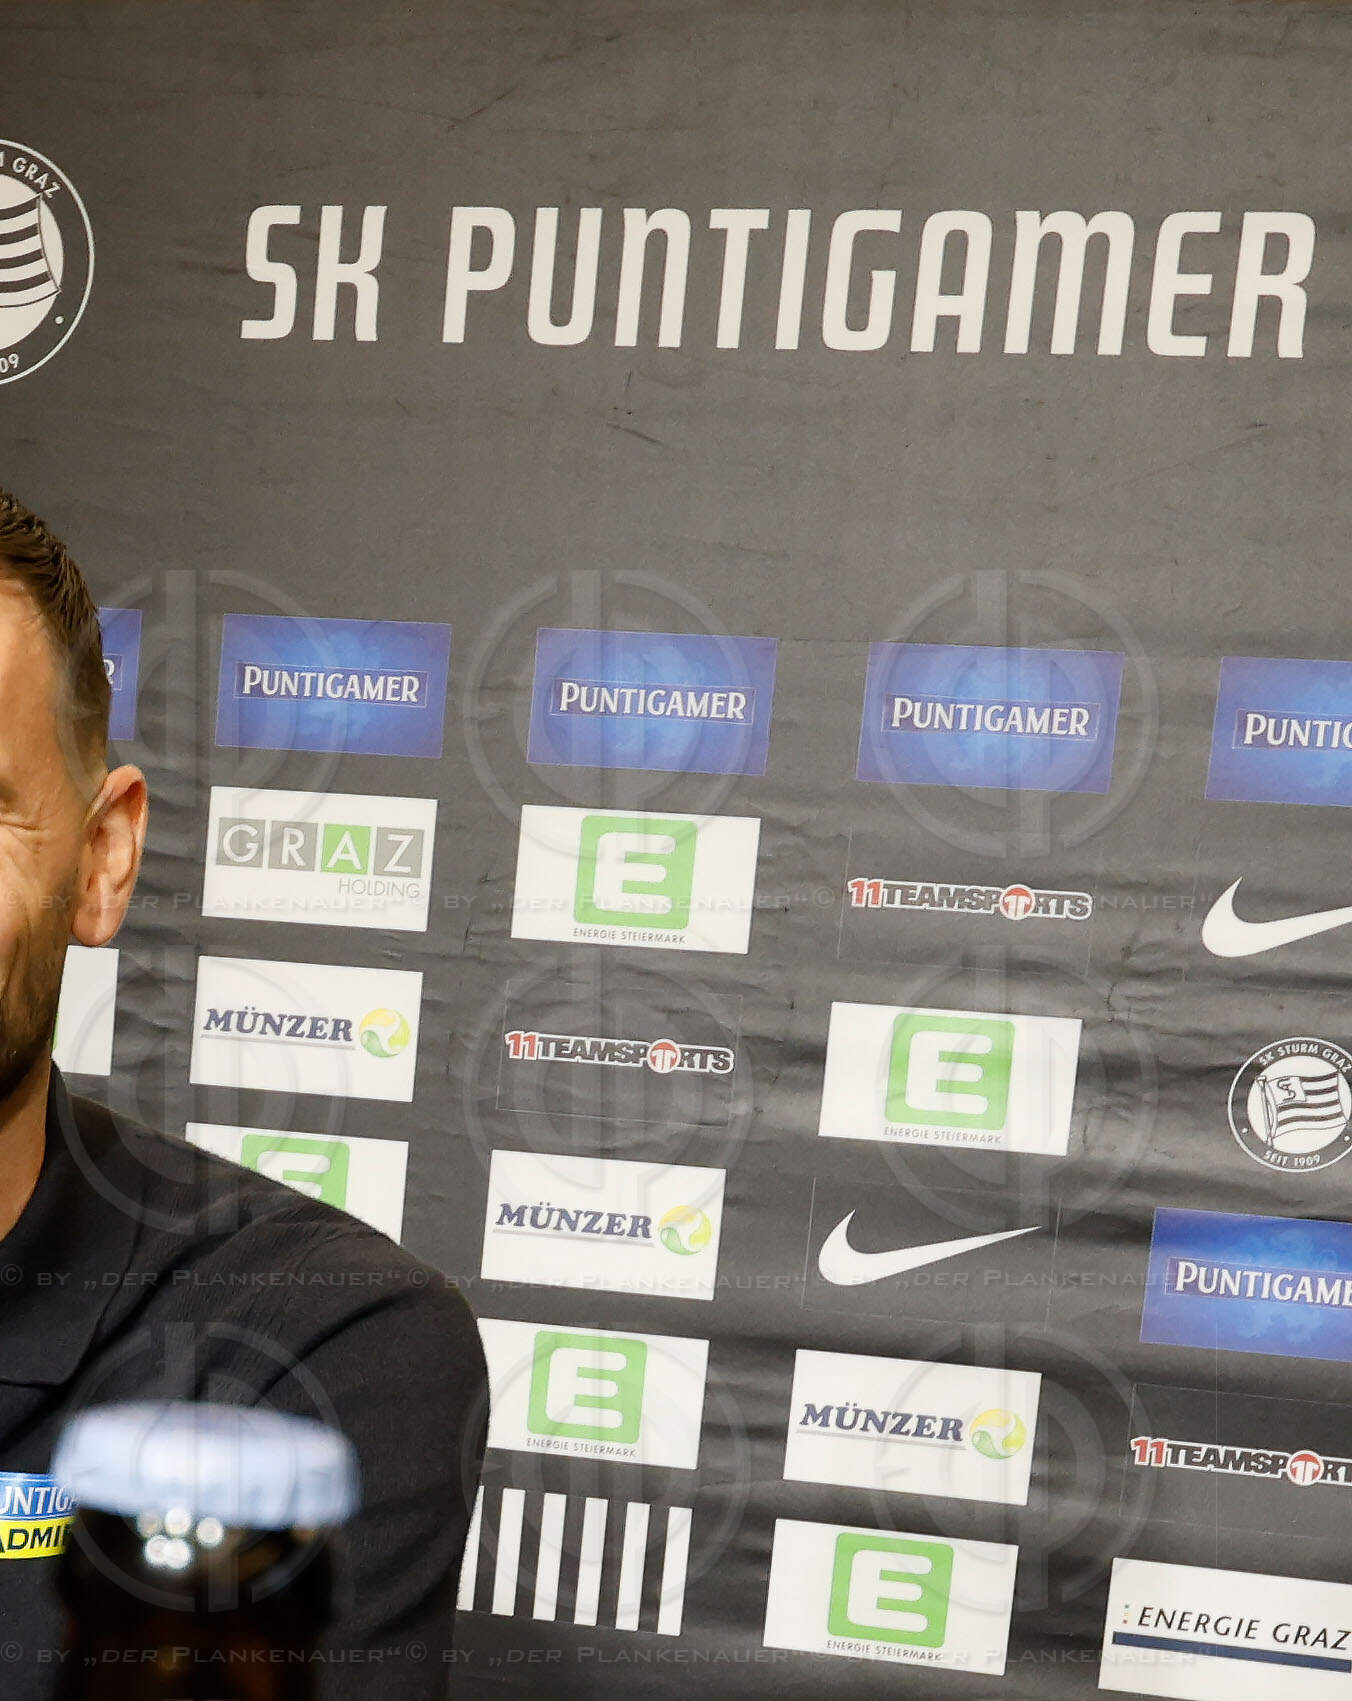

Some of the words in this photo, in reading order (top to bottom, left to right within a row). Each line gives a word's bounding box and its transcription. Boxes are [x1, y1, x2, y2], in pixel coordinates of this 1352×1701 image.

[12, 157, 61, 199] GRAZ
[240, 204, 388, 342] SK
[243, 664, 420, 704] PUNTIGAMER
[559, 682, 747, 720] PUNTIGAMER
[890, 697, 1091, 737] PUNTIGAMER
[1244, 713, 1352, 749] PUNTI
[223, 823, 416, 873] GRAZ
[338, 876, 421, 900] HOLDING
[573, 927, 617, 941] ENERGIE
[621, 931, 687, 945] STEIERMARK
[202, 1006, 354, 1043] MÜNZER
[1278, 1044, 1319, 1056] STURM
[883, 1125, 930, 1141] ENERGIE
[933, 1129, 1003, 1146] STEIERMARK
[1264, 1150, 1288, 1166] SEIT
[1294, 1154, 1321, 1167] 1909
[496, 1201, 653, 1240] MÜNZER
[1176, 1260, 1352, 1309] PUNTIGAME
[800, 1401, 965, 1444] MÜNZER
[526, 1437, 569, 1453] ENERGIE
[1130, 1436, 1352, 1487] 11TEAMSPORT
[1138, 1606, 1261, 1640] ENERGIE
[1272, 1622, 1352, 1651] GRAZ
[826, 1640, 872, 1656] ENERGIE
